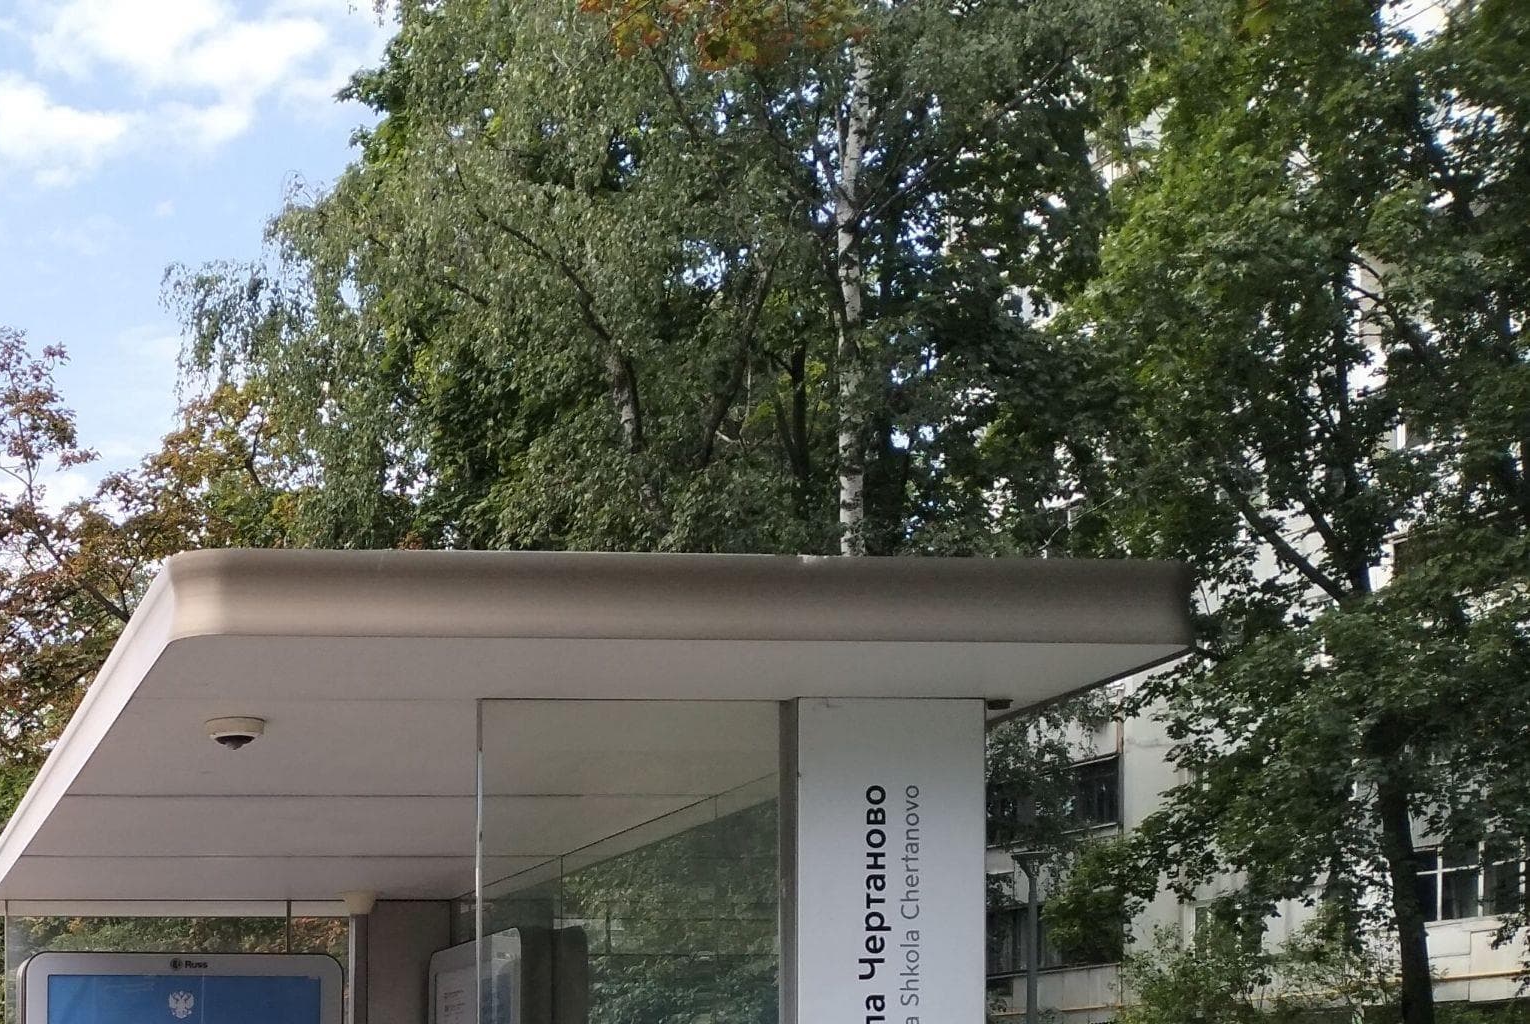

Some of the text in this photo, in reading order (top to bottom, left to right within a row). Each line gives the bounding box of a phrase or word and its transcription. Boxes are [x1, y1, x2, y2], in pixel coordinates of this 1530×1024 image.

[858, 785, 892, 980] Чертаново
[899, 784, 920, 920] Chertanovo
[184, 960, 208, 969] Russ
[899, 927, 920, 1007] Shkola
